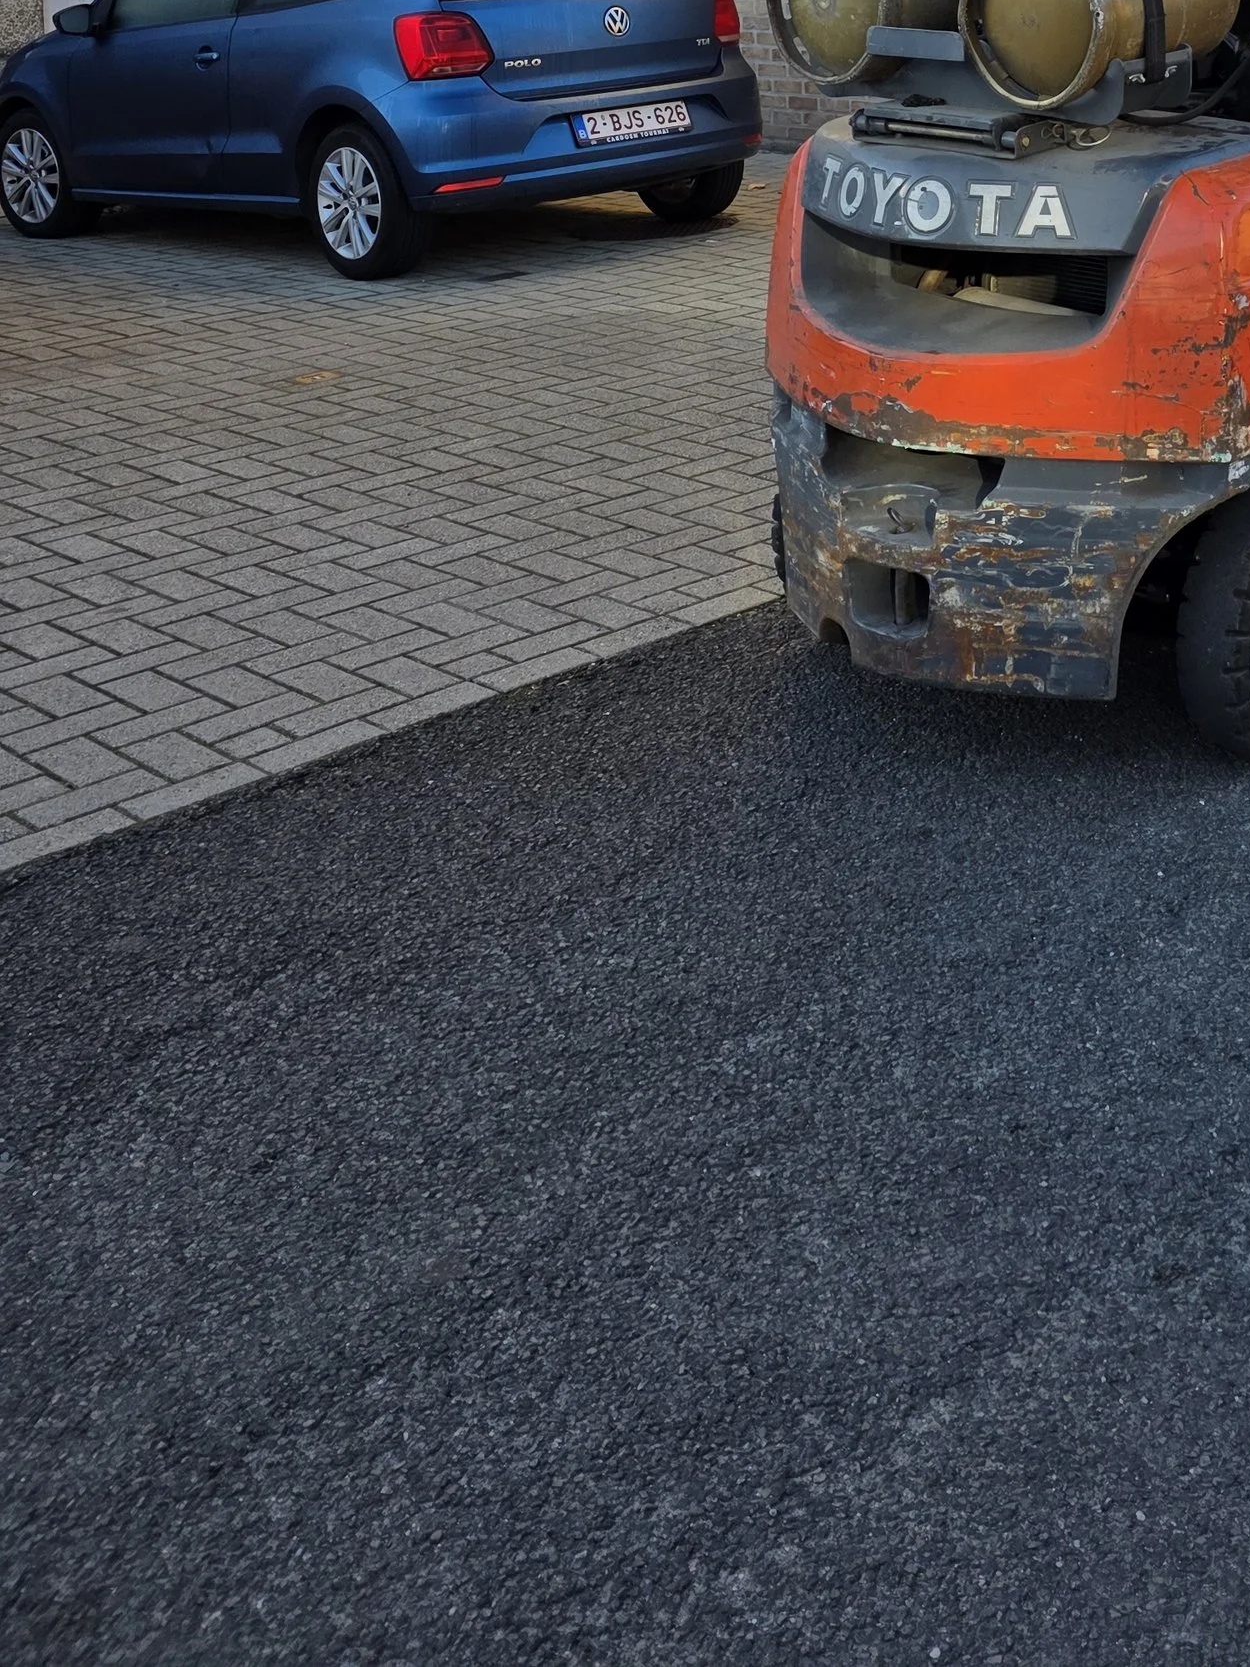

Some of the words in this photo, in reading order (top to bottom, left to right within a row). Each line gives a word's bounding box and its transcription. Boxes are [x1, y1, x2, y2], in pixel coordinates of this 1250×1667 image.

[696, 37, 710, 47] TDI
[504, 58, 542, 69] POLO
[578, 129, 587, 139] B
[820, 154, 1077, 239] TOYOTA
